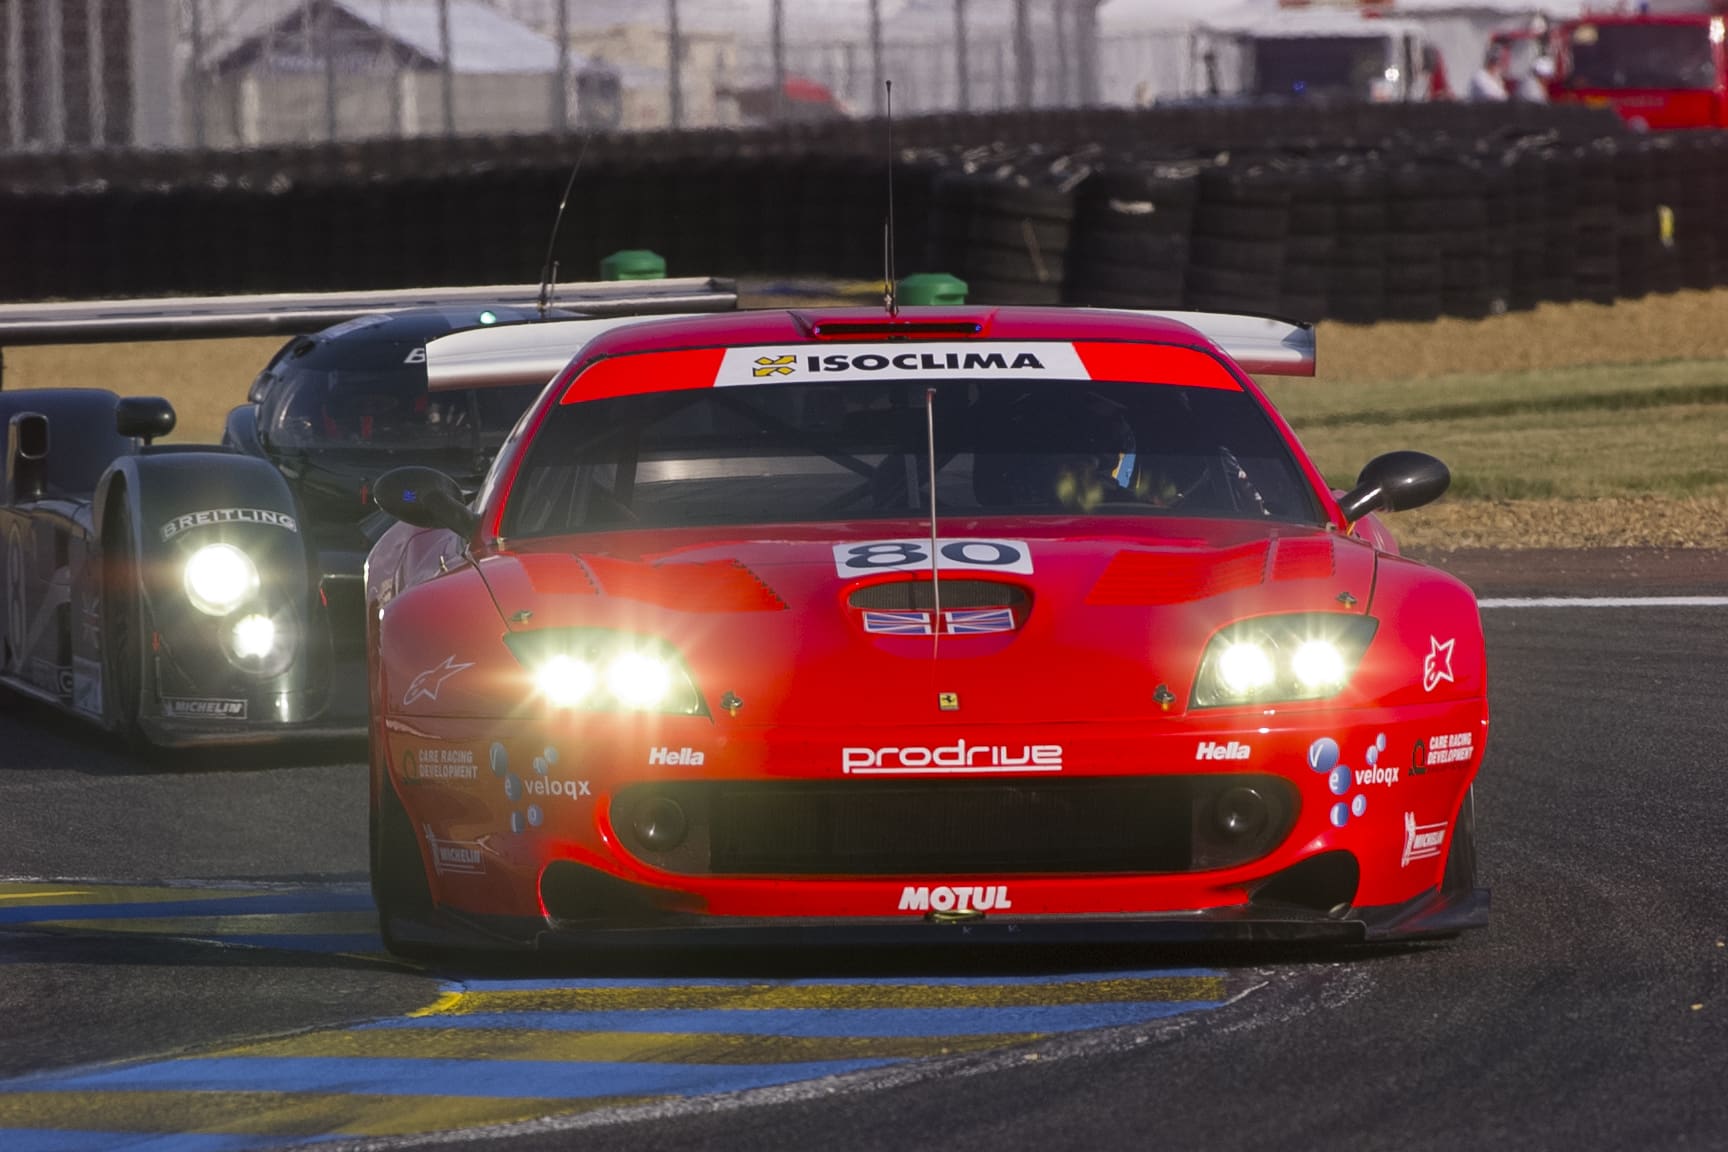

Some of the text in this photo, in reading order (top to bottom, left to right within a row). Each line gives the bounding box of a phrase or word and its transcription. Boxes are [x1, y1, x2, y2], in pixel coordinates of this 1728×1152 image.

[807, 353, 1045, 372] ISOCLIMA
[163, 509, 297, 539] BREITLING
[845, 541, 1021, 568] 80
[175, 701, 242, 713] MICHELIN
[418, 750, 473, 765] CARE RACING
[649, 746, 704, 766] Hella
[842, 738, 1063, 773] prodrive
[1195, 741, 1251, 761] Hella
[419, 764, 478, 780] DEVELOPMENT
[1355, 764, 1399, 788] veloqx
[524, 776, 591, 800] veloqx
[898, 886, 1012, 911] MOTUL
